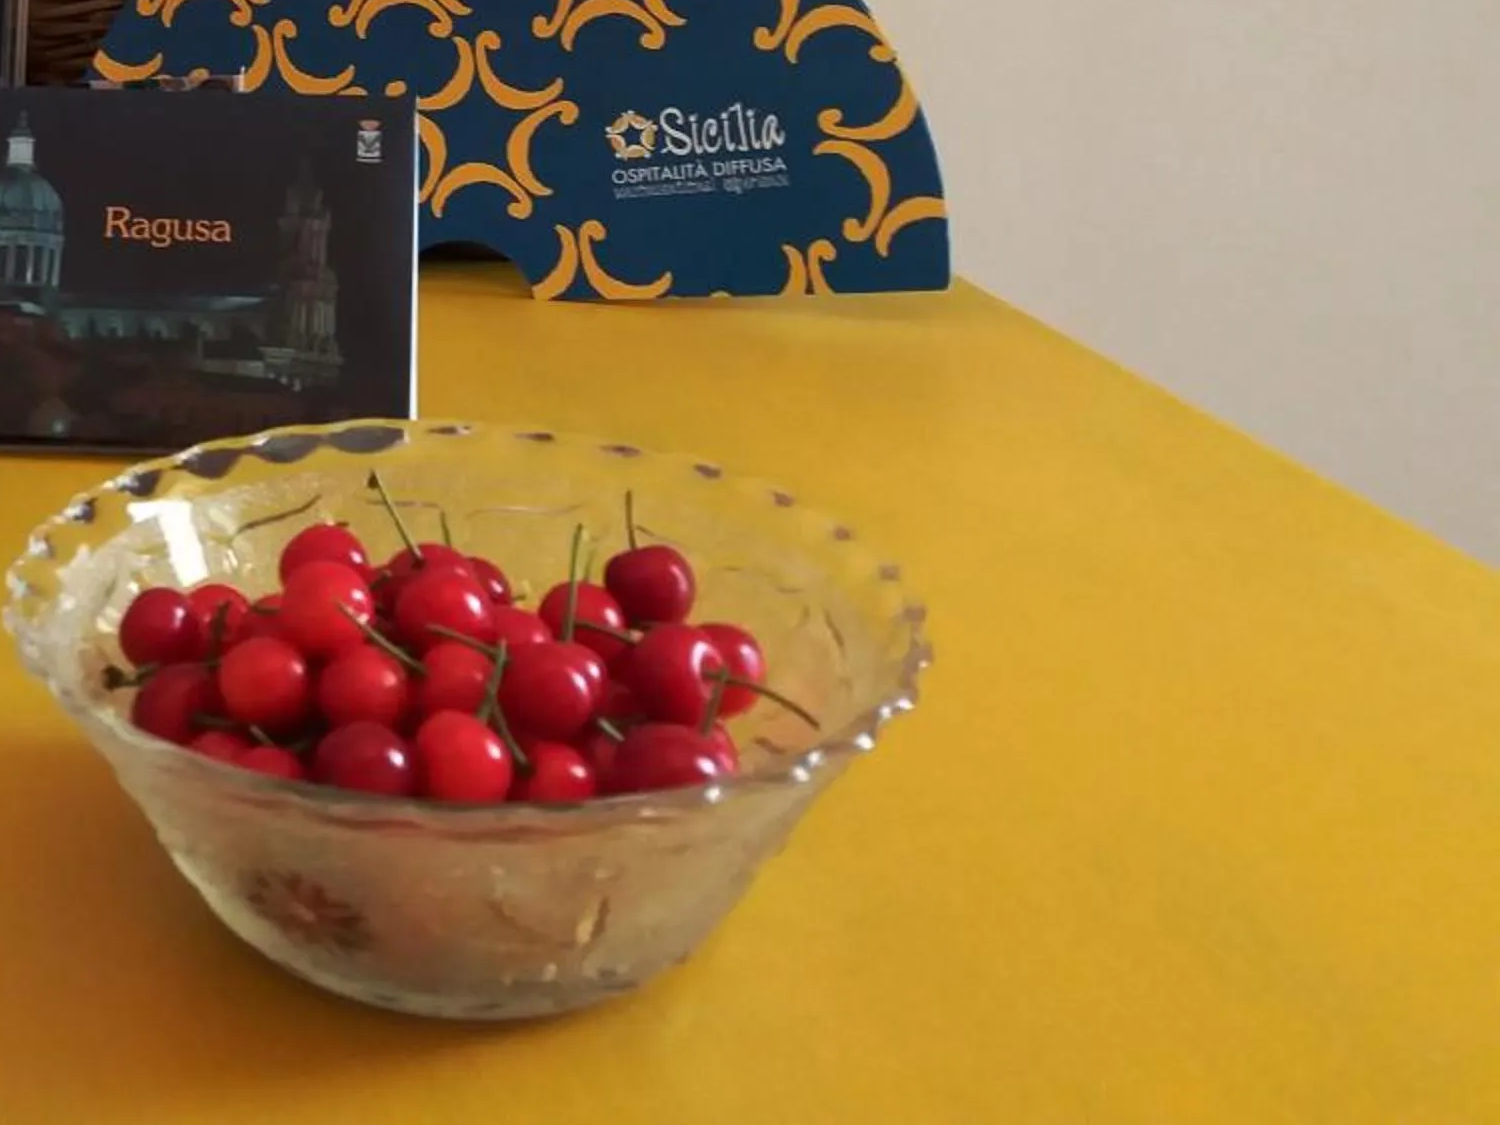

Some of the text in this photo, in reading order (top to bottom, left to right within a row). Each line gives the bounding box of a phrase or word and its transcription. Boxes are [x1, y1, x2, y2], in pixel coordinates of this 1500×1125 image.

[658, 101, 787, 156] Sicilia
[610, 156, 788, 185] OSPITALITÀ DIFFUSA
[103, 206, 233, 249] Ragusa
